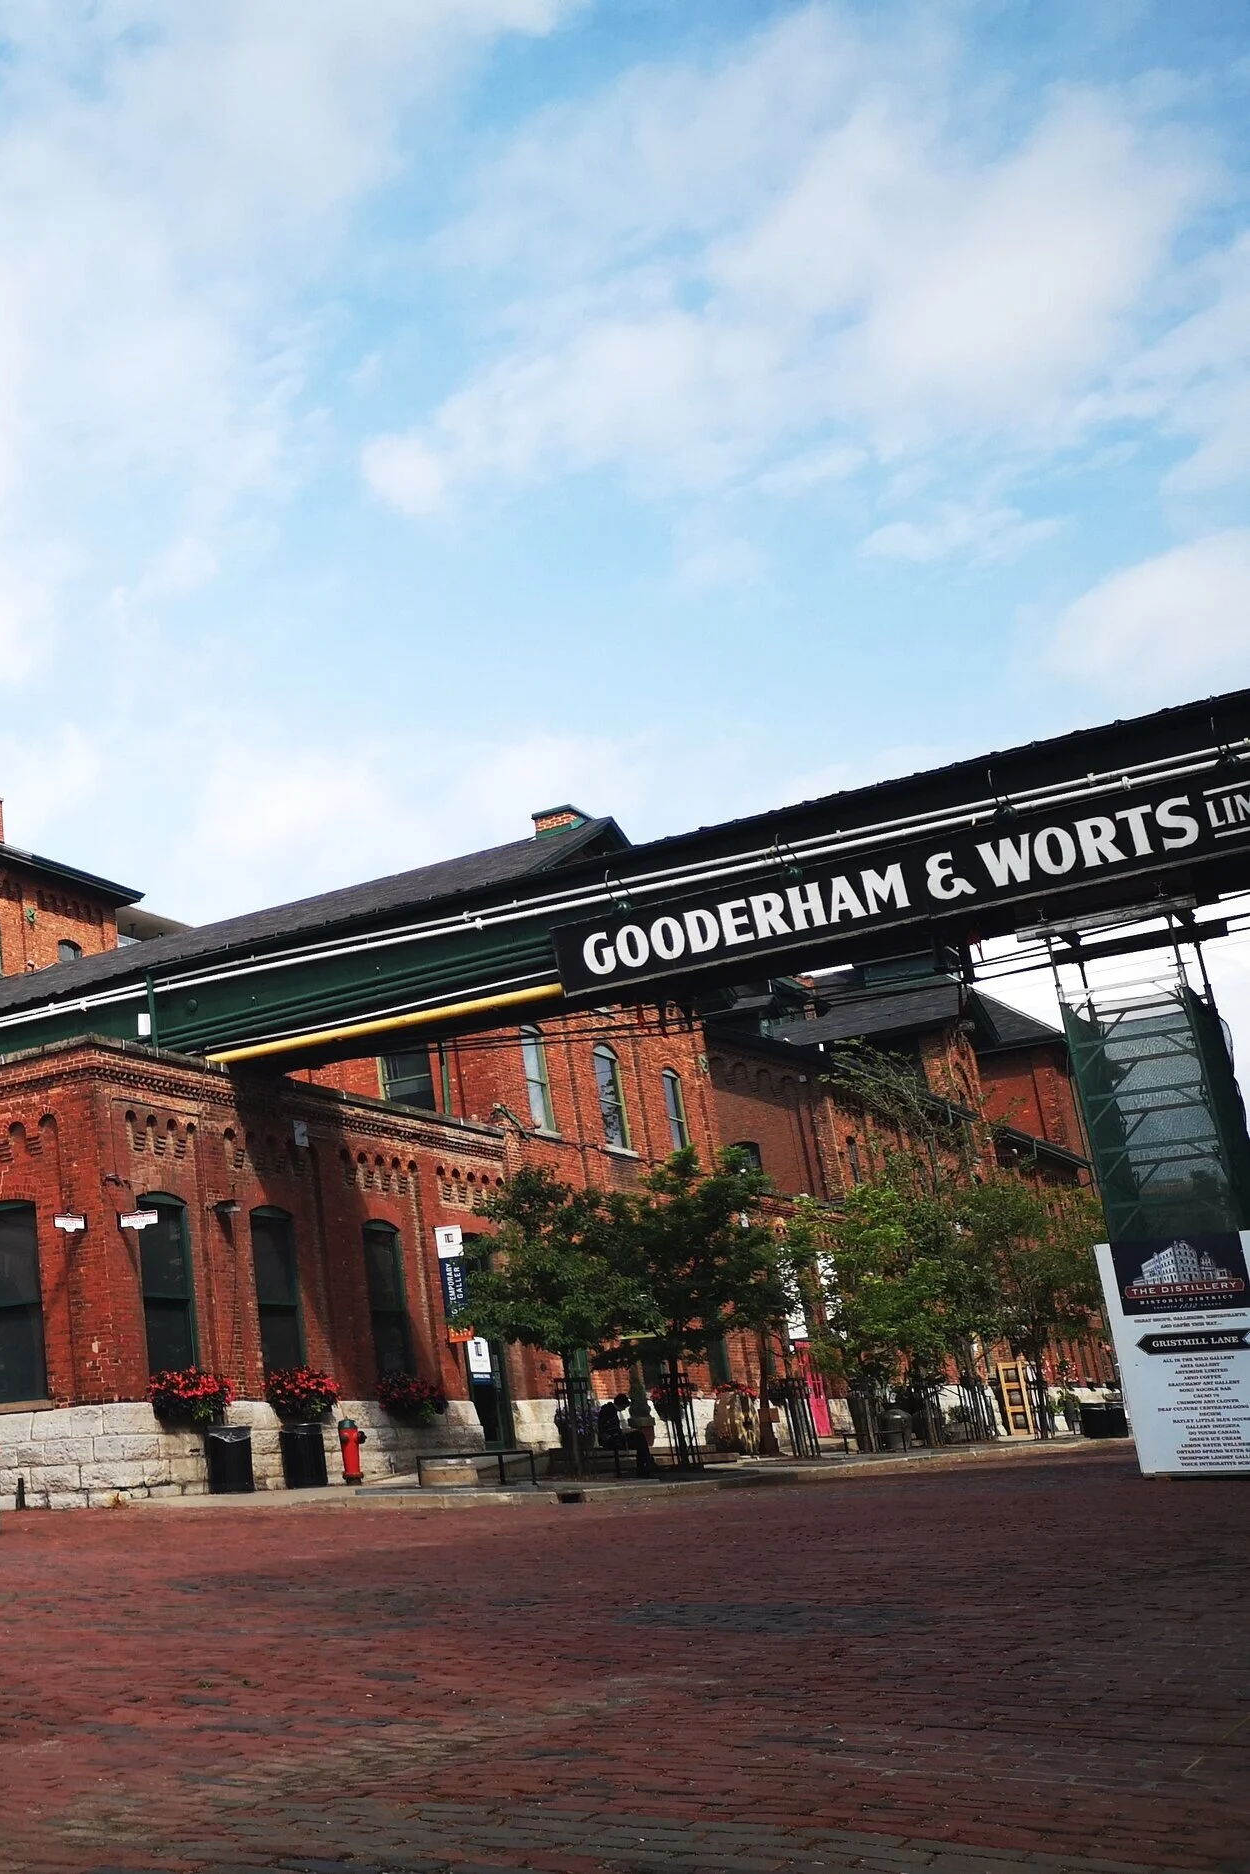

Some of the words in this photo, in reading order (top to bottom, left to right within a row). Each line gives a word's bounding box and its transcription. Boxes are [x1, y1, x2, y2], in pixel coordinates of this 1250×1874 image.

[582, 862, 912, 975] GOODERHAM
[925, 851, 977, 900] &
[974, 795, 1200, 888] WORTS
[1161, 1282, 1237, 1293] DISTILLERY
[1152, 1338, 1209, 1348] GRISTMILL
[1210, 1336, 1239, 1344] LANE
